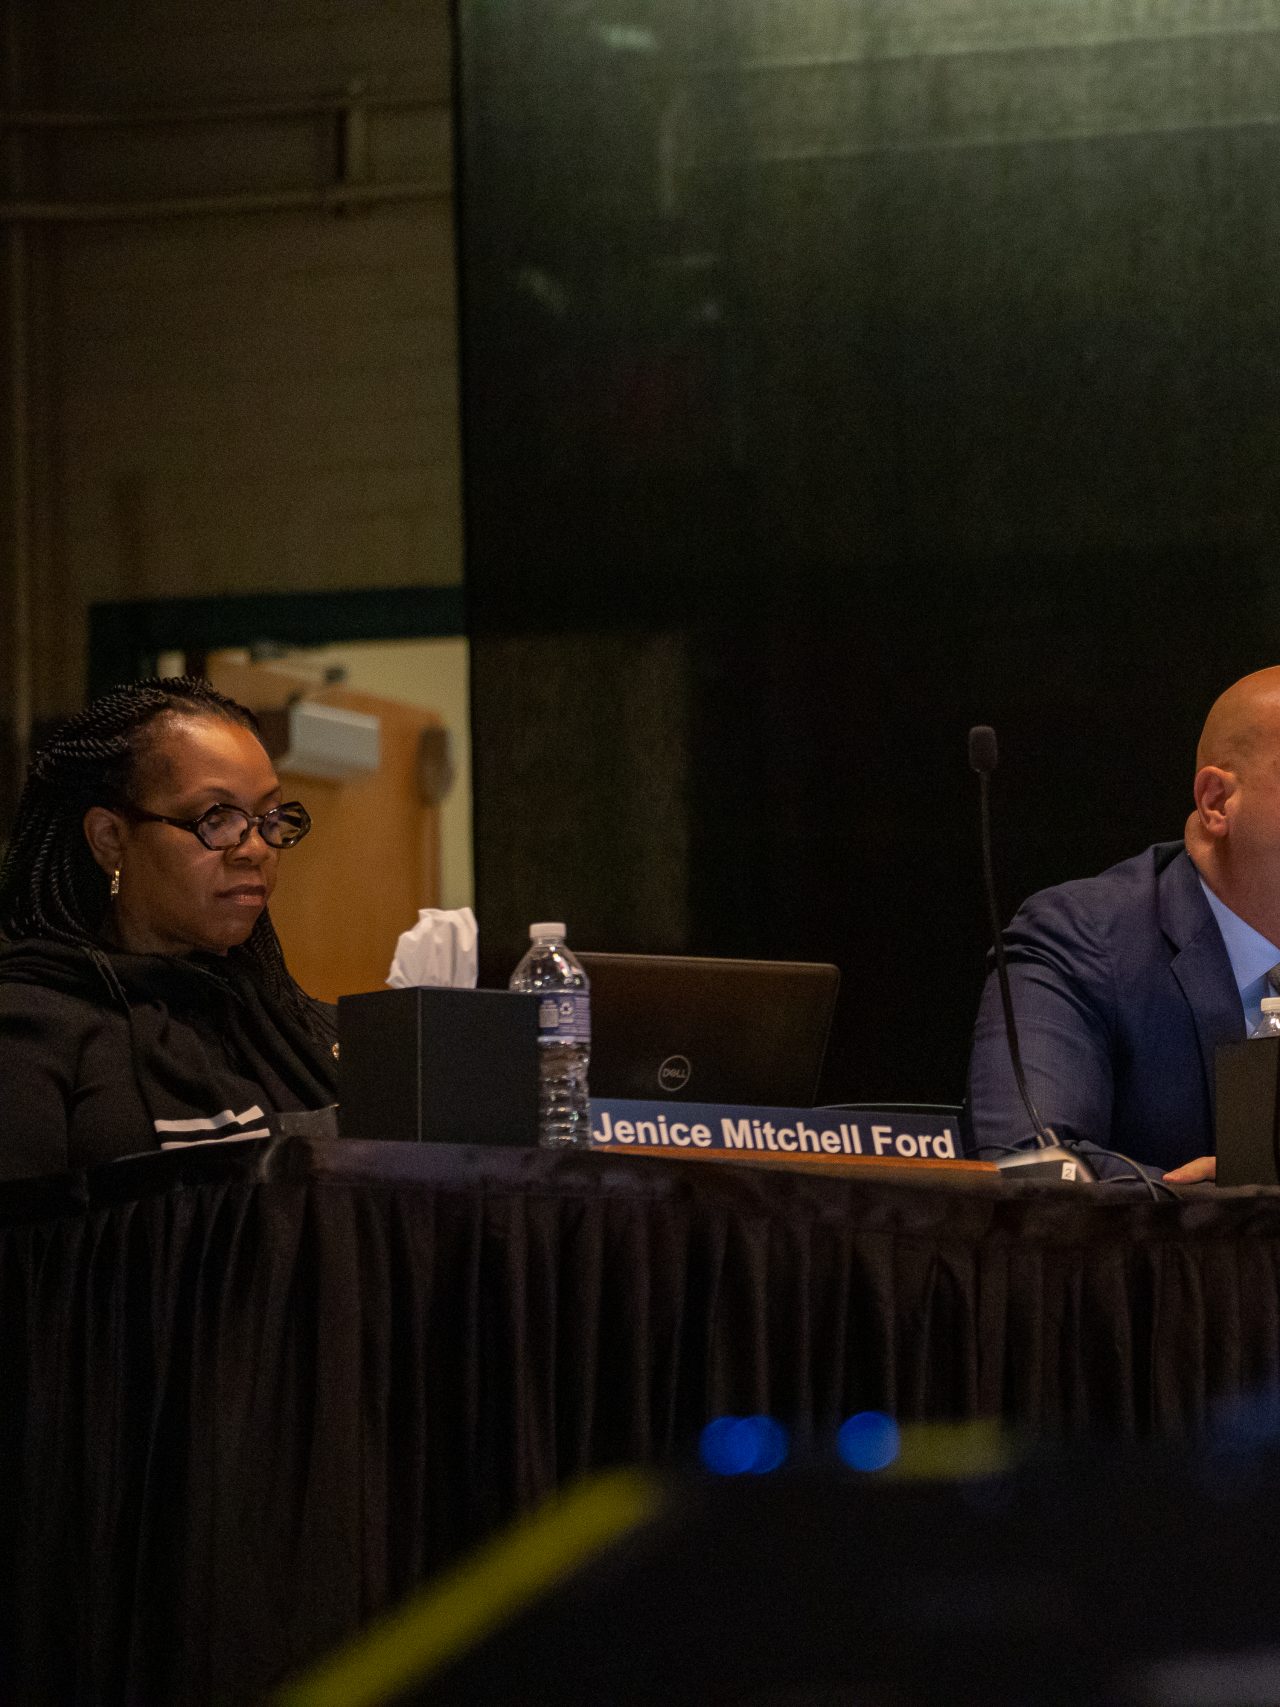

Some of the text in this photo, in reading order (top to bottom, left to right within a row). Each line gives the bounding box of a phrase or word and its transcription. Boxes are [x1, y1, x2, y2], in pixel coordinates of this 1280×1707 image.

[593, 1112, 956, 1159] Jenice Mitchell Ford
